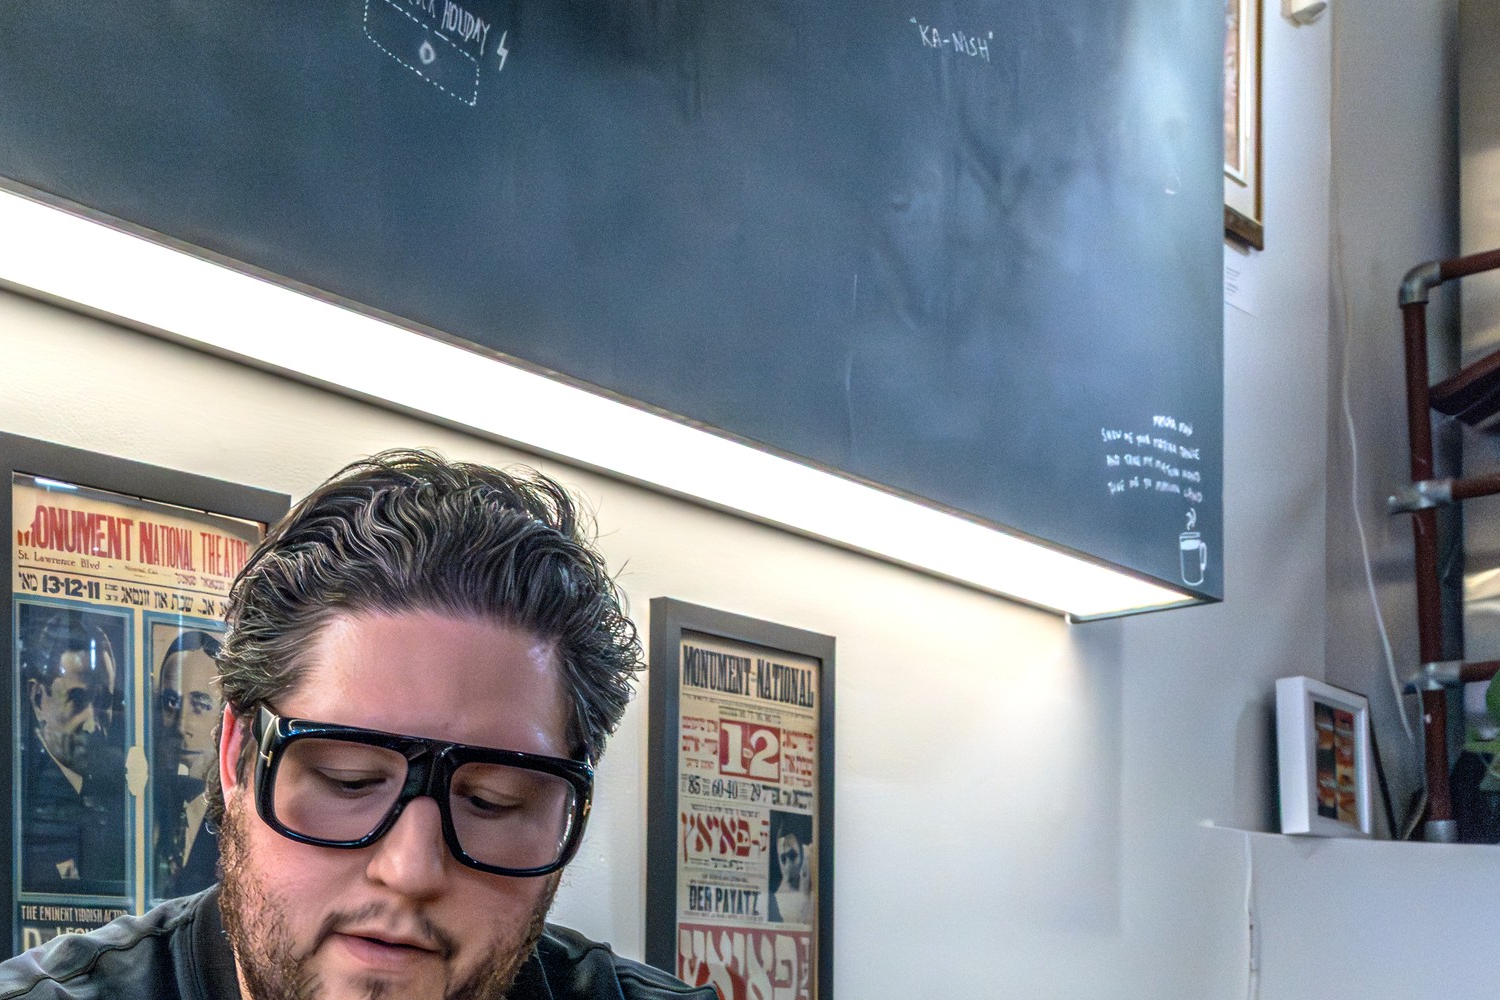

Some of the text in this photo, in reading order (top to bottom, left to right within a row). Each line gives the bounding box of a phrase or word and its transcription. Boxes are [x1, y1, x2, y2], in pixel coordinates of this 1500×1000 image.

[441, 0, 491, 57] HOLIDAY
[34, 551, 76, 567] Lawrence
[139, 521, 196, 572] NATIONAL
[21, 905, 38, 920] THE
[40, 906, 74, 921] EMINENT
